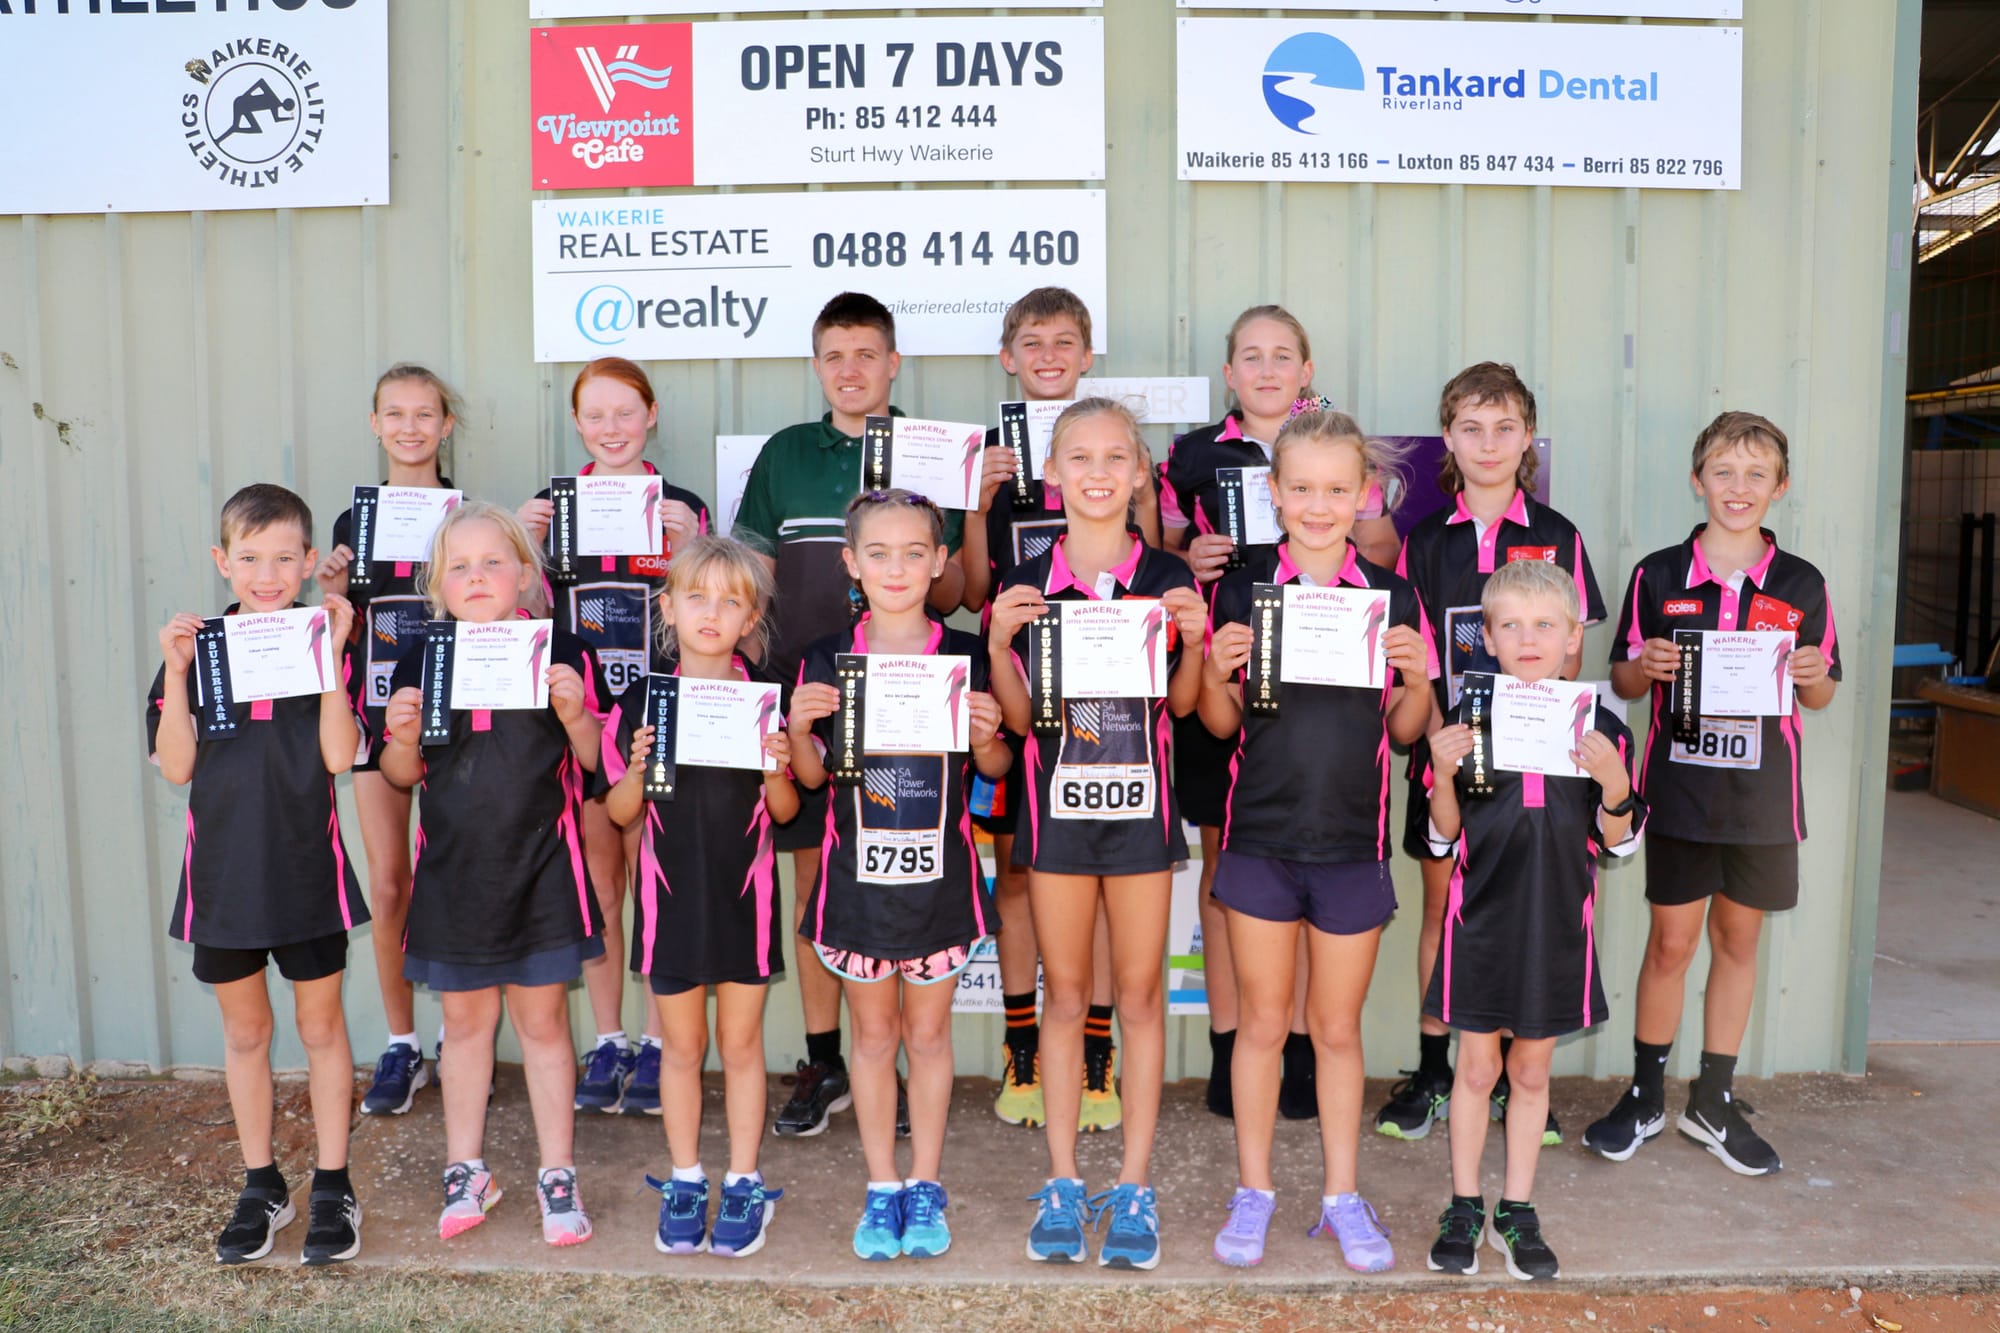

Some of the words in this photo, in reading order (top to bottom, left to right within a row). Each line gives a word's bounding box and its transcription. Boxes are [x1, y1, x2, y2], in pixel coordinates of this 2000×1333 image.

[190, 38, 312, 85] WAIKERIE
[741, 44, 865, 91] OPEN
[886, 43, 914, 88] 7
[936, 41, 1063, 87] DAYS
[1376, 67, 1525, 98] Tankard
[1540, 70, 1657, 100] Dental
[1383, 97, 1462, 110] Riverland
[806, 107, 845, 130] Ph:
[856, 106, 885, 129] 85
[896, 105, 941, 128] 412
[951, 105, 997, 127] 444
[285, 82, 325, 173] LITTLE
[537, 112, 680, 144] Viewpoint
[182, 92, 279, 188] ATHLETICS
[572, 138, 644, 169] Cafe
[811, 146, 855, 163] Sturt
[863, 145, 903, 166] Hwy
[910, 144, 993, 161] Waikerie
[1185, 152, 1264, 169] Waikerie
[1272, 152, 1292, 168] 85
[1299, 152, 1330, 168] 413
[1338, 153, 1368, 169] 166
[1398, 153, 1453, 170] Loxton
[1460, 154, 1480, 171] 85
[1487, 155, 1517, 171] 847
[1524, 156, 1554, 172] 434
[1584, 157, 1623, 173] Berri
[1630, 158, 1649, 174] 85
[1656, 159, 1686, 175] 822
[1693, 160, 1723, 176] 796
[558, 209, 663, 226] WAIKERIE
[560, 232, 641, 259] REAL
[651, 229, 768, 256] ESTATE
[813, 232, 906, 268] 0488
[923, 231, 993, 266] 414
[1009, 230, 1079, 266] 460
[576, 285, 768, 344] @realty
[904, 425, 947, 435] WAIKERIE
[586, 480, 627, 489] WAIKERIE
[388, 491, 428, 500] WAIKERIE
[357, 505, 369, 576] SUPERSTAR
[560, 498, 570, 572] SUPERSTAR
[605, 597, 616, 606] SA
[1296, 592, 1346, 604] WAIKERIE
[398, 610, 408, 618] SA
[605, 606, 628, 614] Power
[1072, 605, 1123, 616] WAIKERIE
[1667, 602, 1697, 614] coles
[237, 616, 287, 629] WAIKERIE
[605, 615, 640, 623] Networks
[467, 626, 513, 636] WAIKERIE
[1712, 636, 1757, 645] WAIKERIE
[1260, 608, 1272, 699] SUPERSTAR
[878, 660, 928, 671] WAIKERIE
[1041, 627, 1053, 718] SUPERSTAR
[208, 640, 227, 721] SUPERSTAR
[432, 644, 445, 727] SUPERSTAR
[690, 684, 739, 695] WAIKERIE
[1505, 682, 1555, 695] WAIKERIE
[1683, 653, 1693, 730] SUPERSTAR
[1102, 701, 1116, 711] SA
[844, 679, 856, 768] SUPERSTAR
[1102, 711, 1130, 722] Power
[1102, 721, 1142, 732] Networks
[654, 698, 668, 783] SUPERSTAR
[898, 768, 912, 778] SA
[898, 778, 926, 789] Power
[898, 787, 938, 798] Networks
[1063, 781, 1145, 809] 6808
[865, 844, 935, 874] 6795
